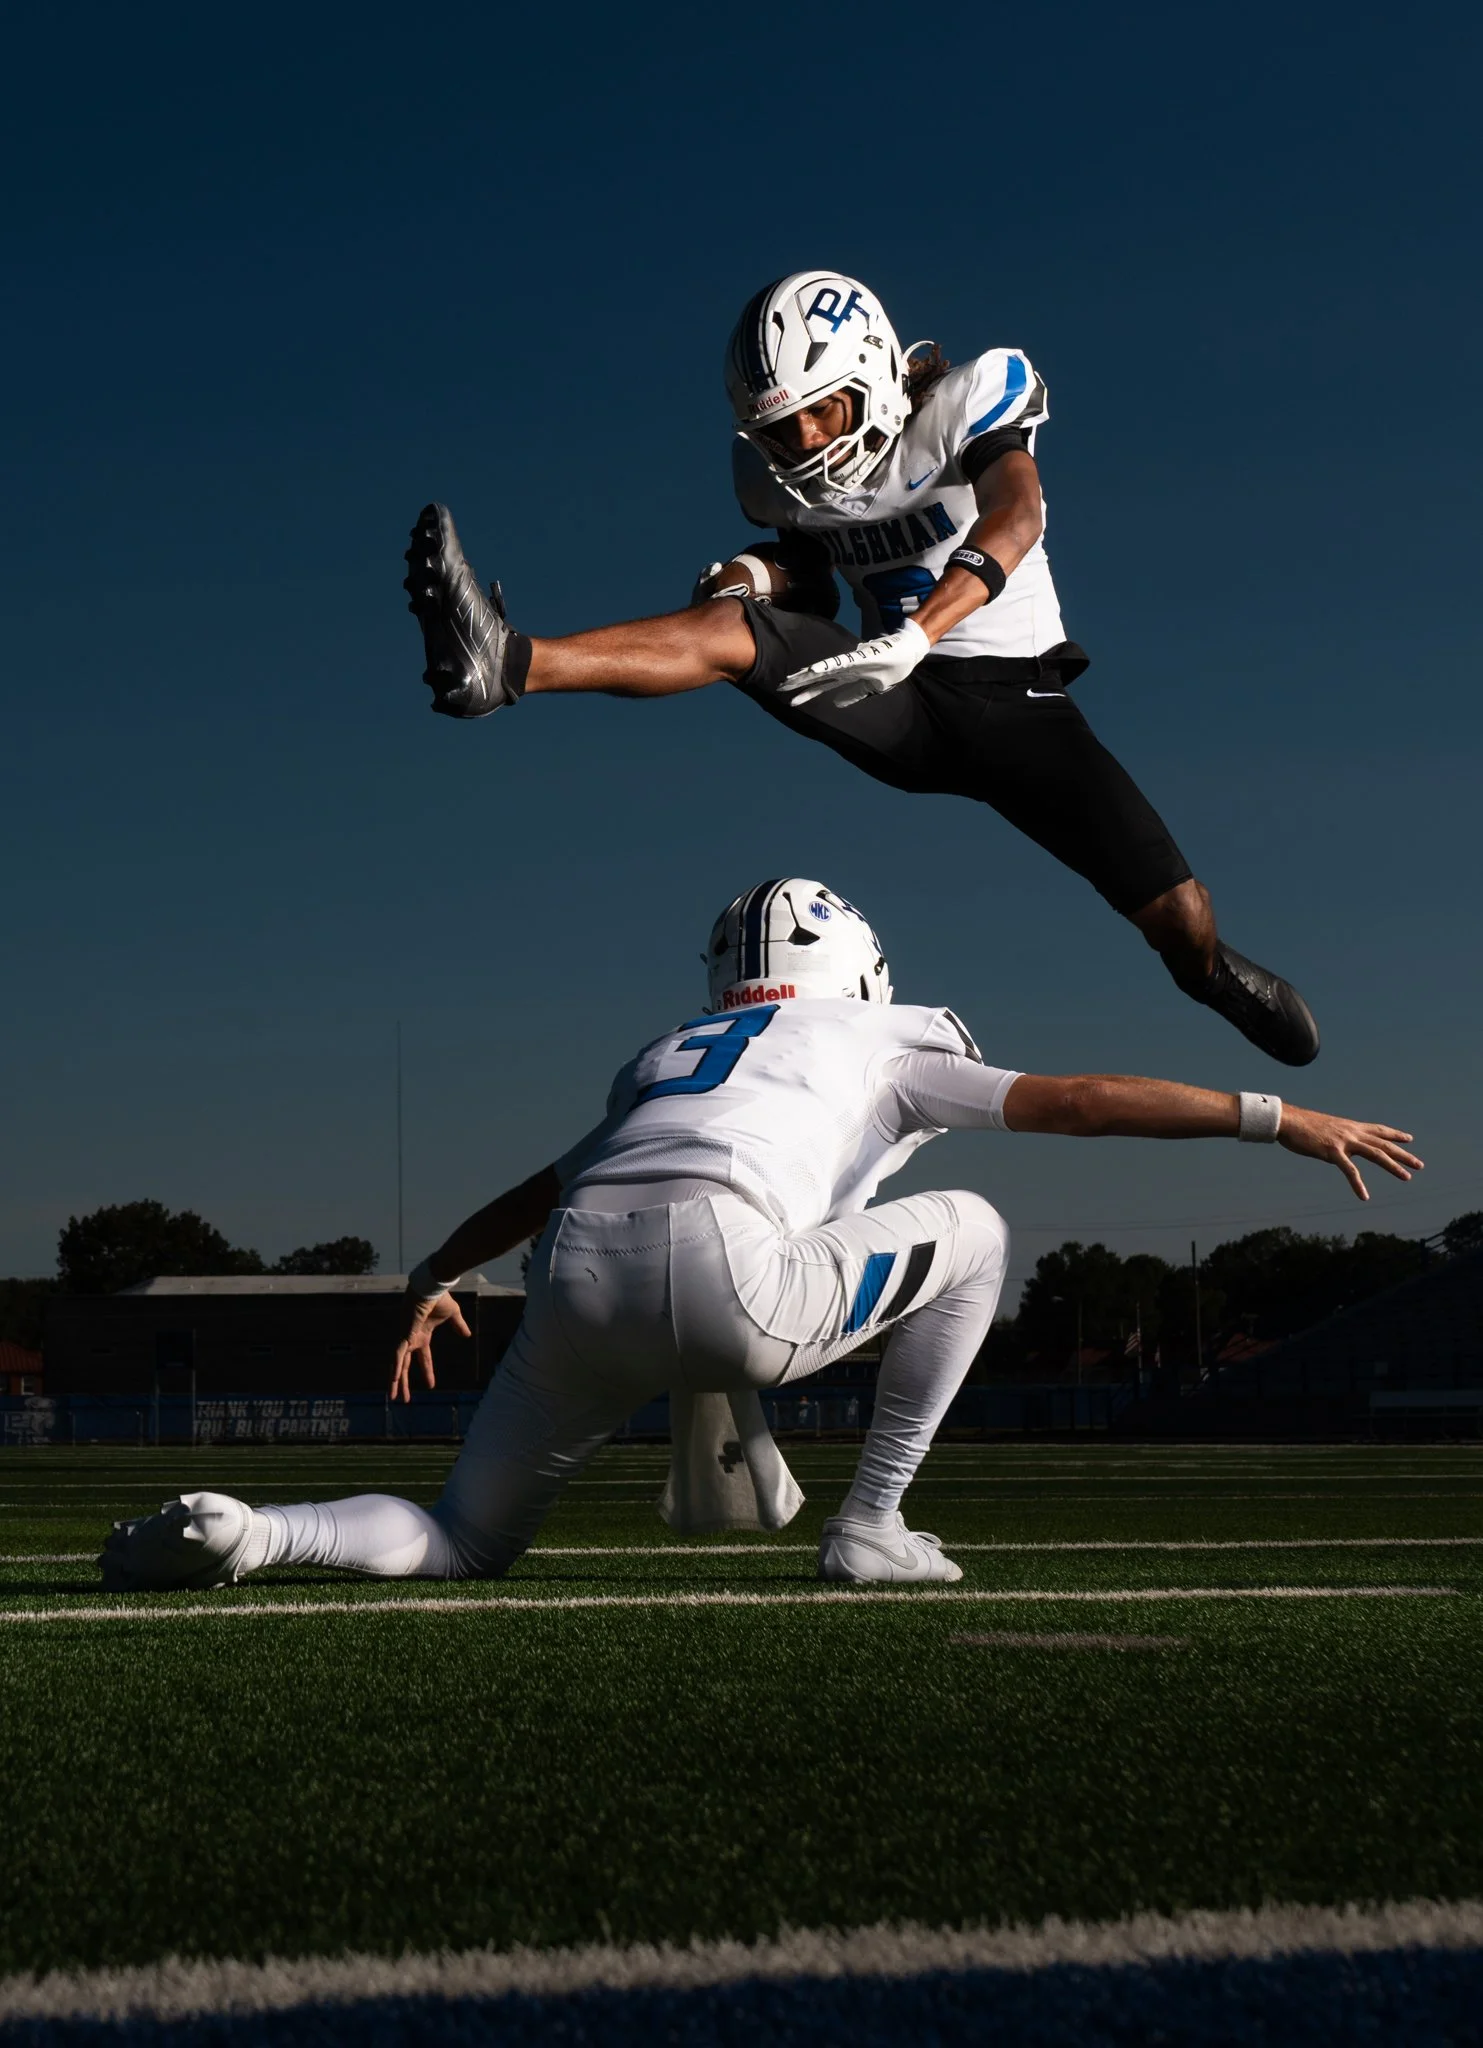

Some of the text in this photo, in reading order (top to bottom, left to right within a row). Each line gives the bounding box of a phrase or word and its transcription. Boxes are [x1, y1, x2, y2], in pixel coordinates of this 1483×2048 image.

[823, 640, 893, 671] JORDAN
[722, 984, 796, 1010] Riddell
[624, 1003, 781, 1116] 3
[195, 1399, 345, 1418] THANK YOU TO OUR
[279, 1418, 350, 1437] PARTNER
